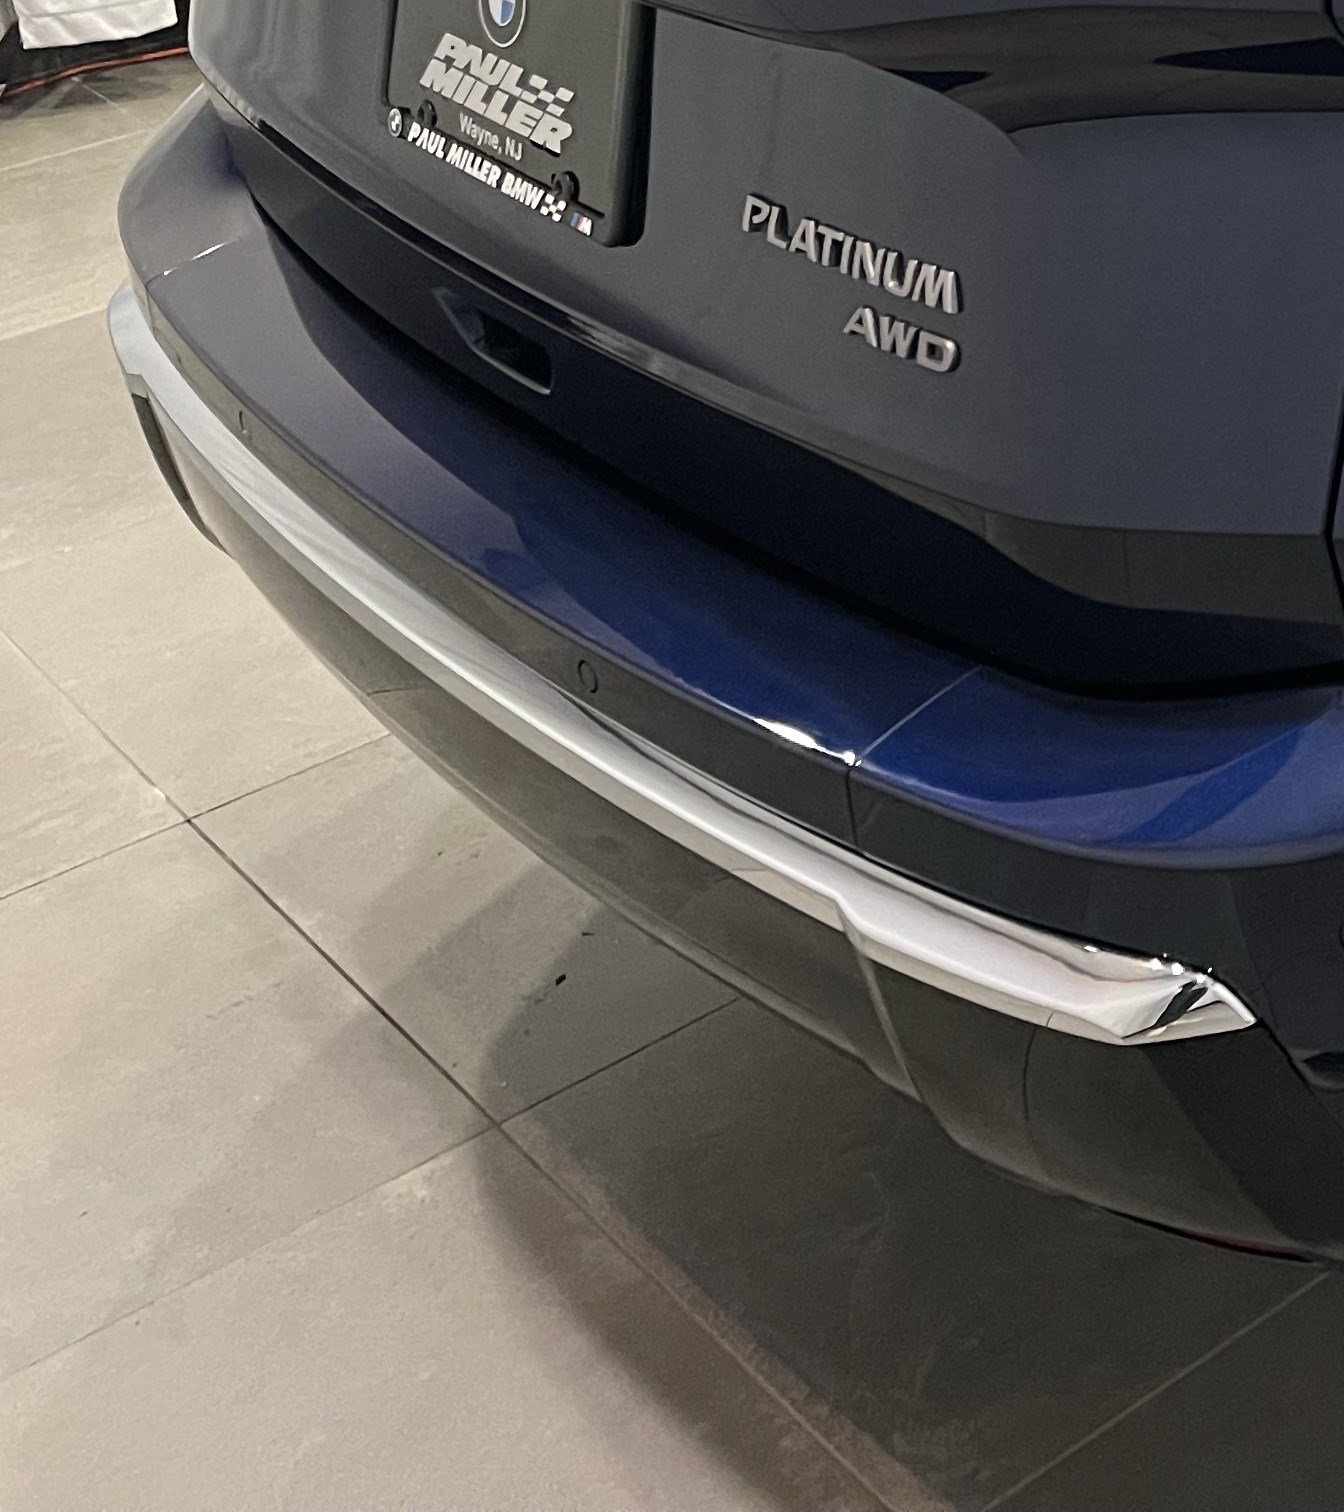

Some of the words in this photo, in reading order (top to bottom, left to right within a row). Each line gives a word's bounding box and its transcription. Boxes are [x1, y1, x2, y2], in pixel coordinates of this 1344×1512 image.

[434, 33, 524, 97] PAUL
[419, 58, 573, 154] MILLER
[407, 121, 446, 159] PAUL
[445, 143, 501, 189] MILLER
[500, 171, 545, 210] BMW
[505, 136, 523, 161] NJ
[742, 194, 959, 315] PLATINUM
[842, 306, 958, 373] AWD
